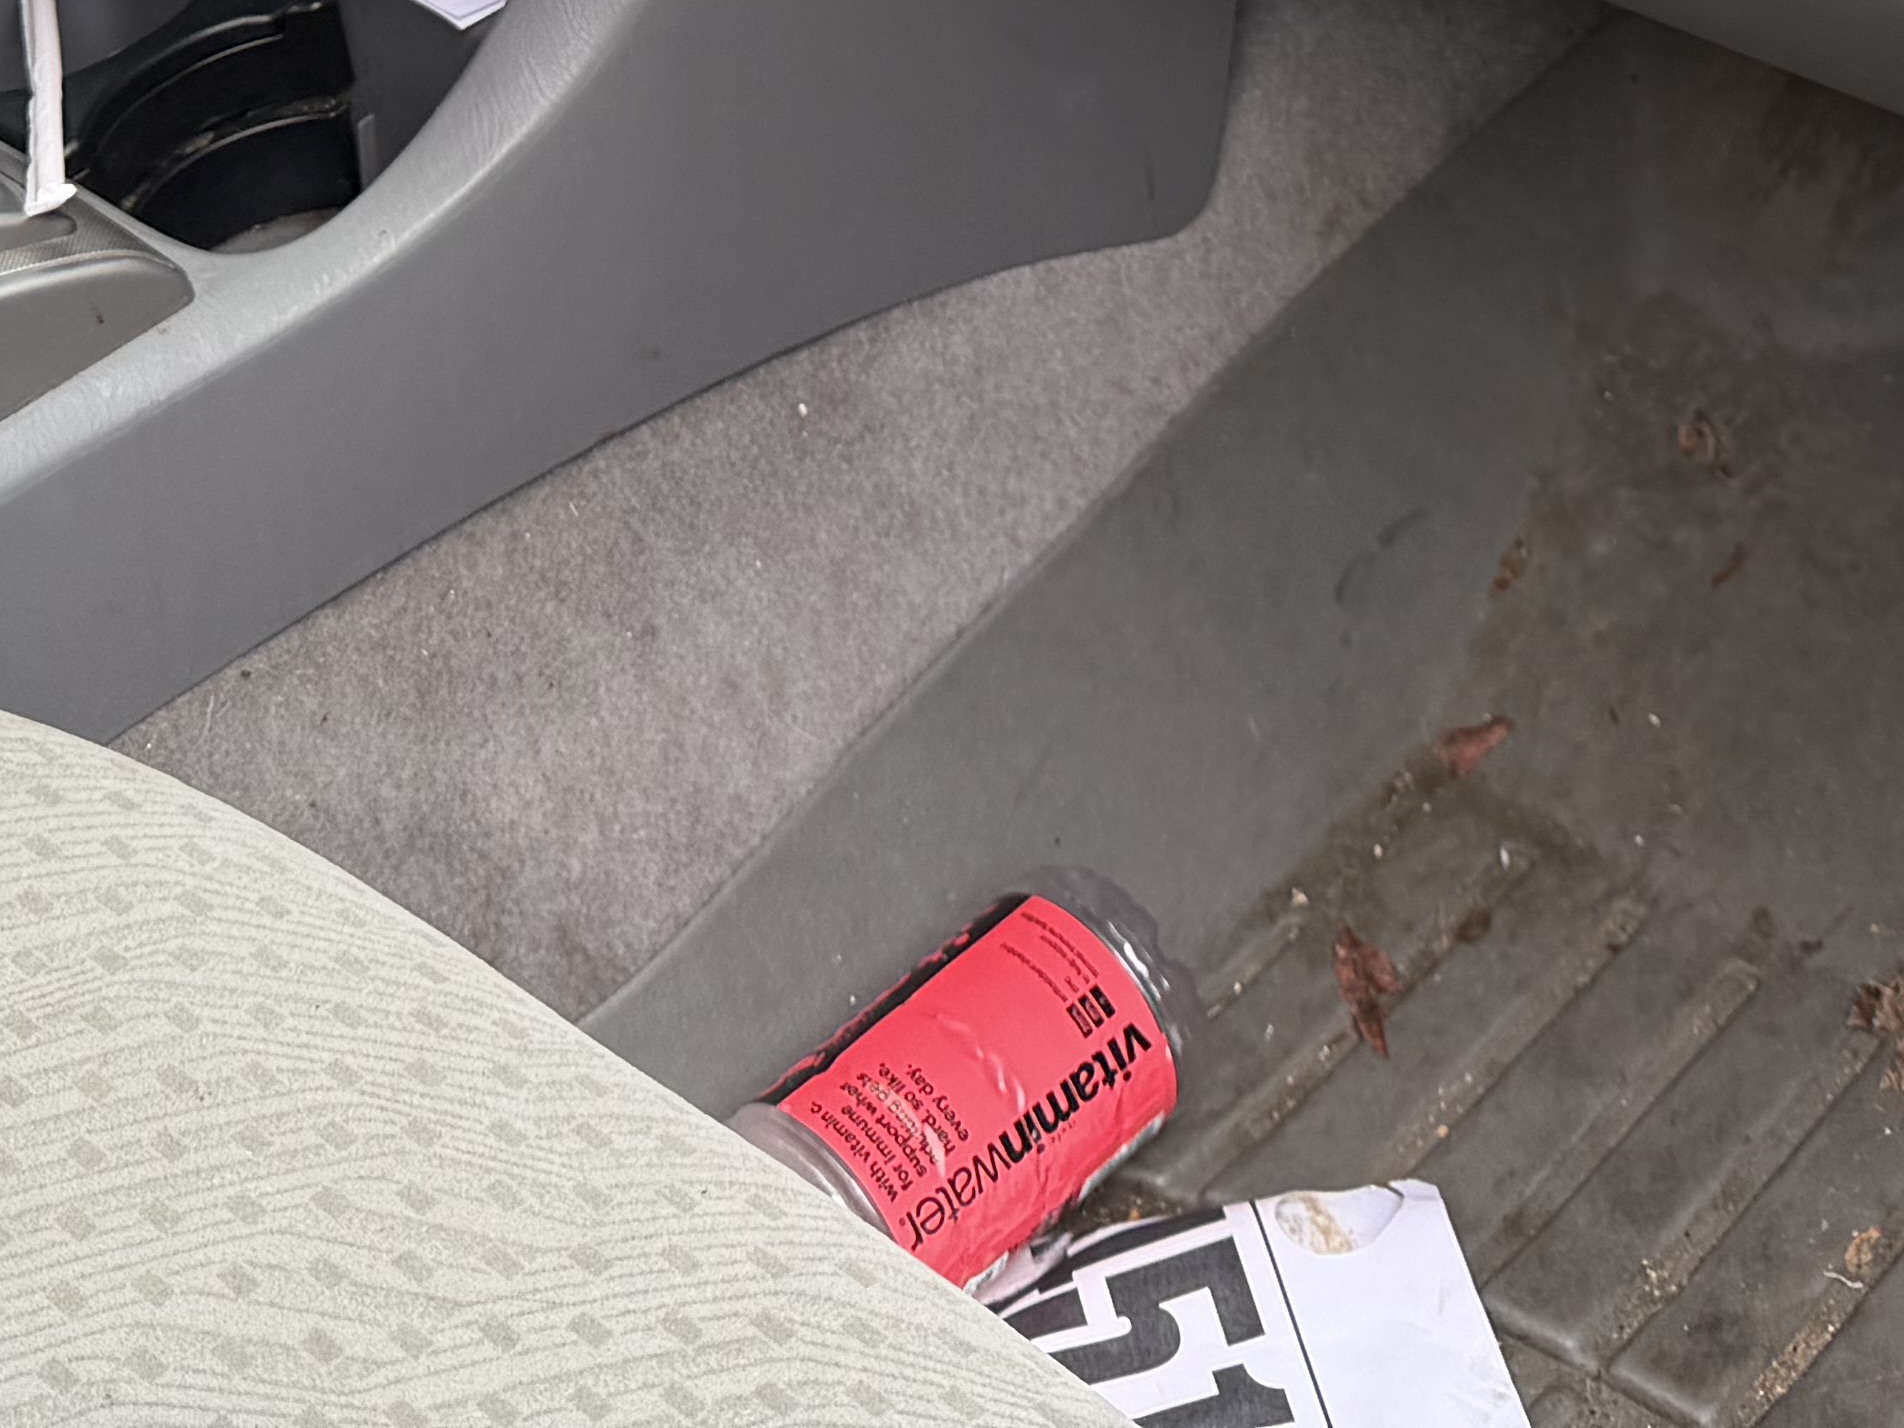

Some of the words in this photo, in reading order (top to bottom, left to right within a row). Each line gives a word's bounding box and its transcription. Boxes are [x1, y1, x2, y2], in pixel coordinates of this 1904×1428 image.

[904, 1091, 924, 1111] so
[931, 1094, 969, 1143] every
[820, 1111, 871, 1164] vitamin
[840, 1104, 896, 1166] immune
[875, 1113, 928, 1179] support
[905, 1022, 1153, 1252] vitaminwater
[869, 1160, 899, 1203] with
[892, 1163, 914, 1192] for
